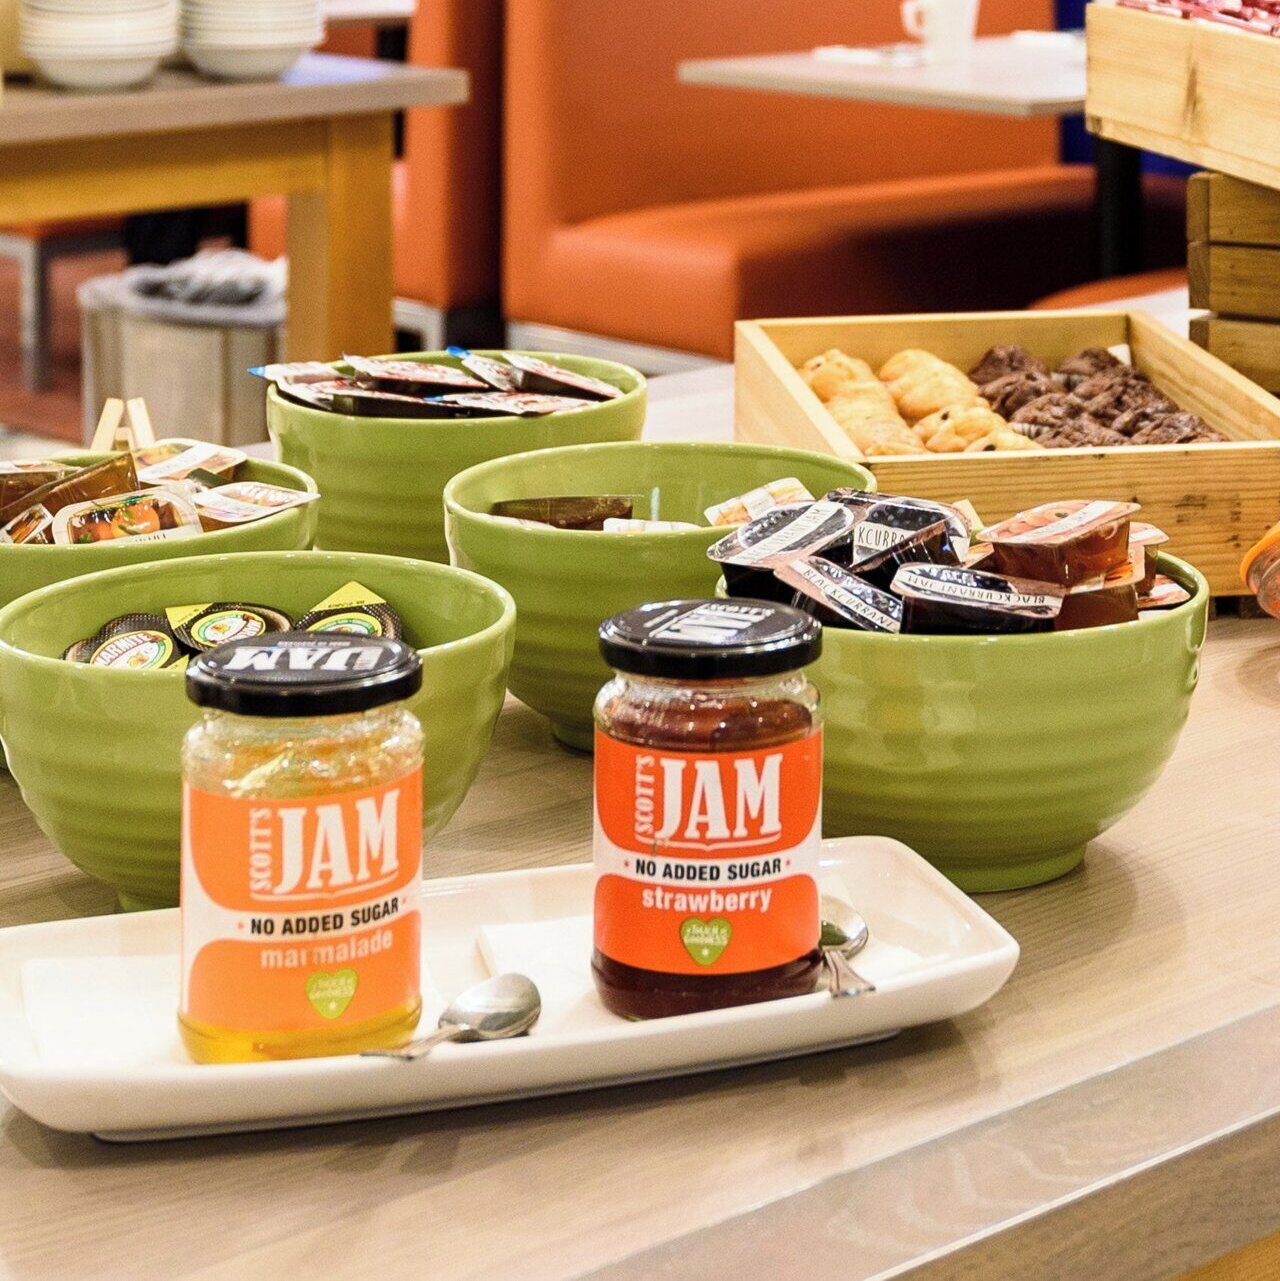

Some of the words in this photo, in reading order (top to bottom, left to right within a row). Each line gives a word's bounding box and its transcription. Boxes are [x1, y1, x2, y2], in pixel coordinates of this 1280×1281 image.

[802, 568, 894, 629] BLACKCURRANT
[941, 582, 1046, 605] BLACKCURRANT
[653, 752, 784, 840] JAM
[272, 787, 400, 895] JAM
[635, 858, 657, 877] NO
[662, 863, 721, 881] ADDED
[727, 857, 782, 881] SUGAR
[250, 917, 275, 936] NO
[281, 912, 344, 936] ADDED
[350, 896, 400, 927] SUGAR
[641, 885, 772, 913] strawberry
